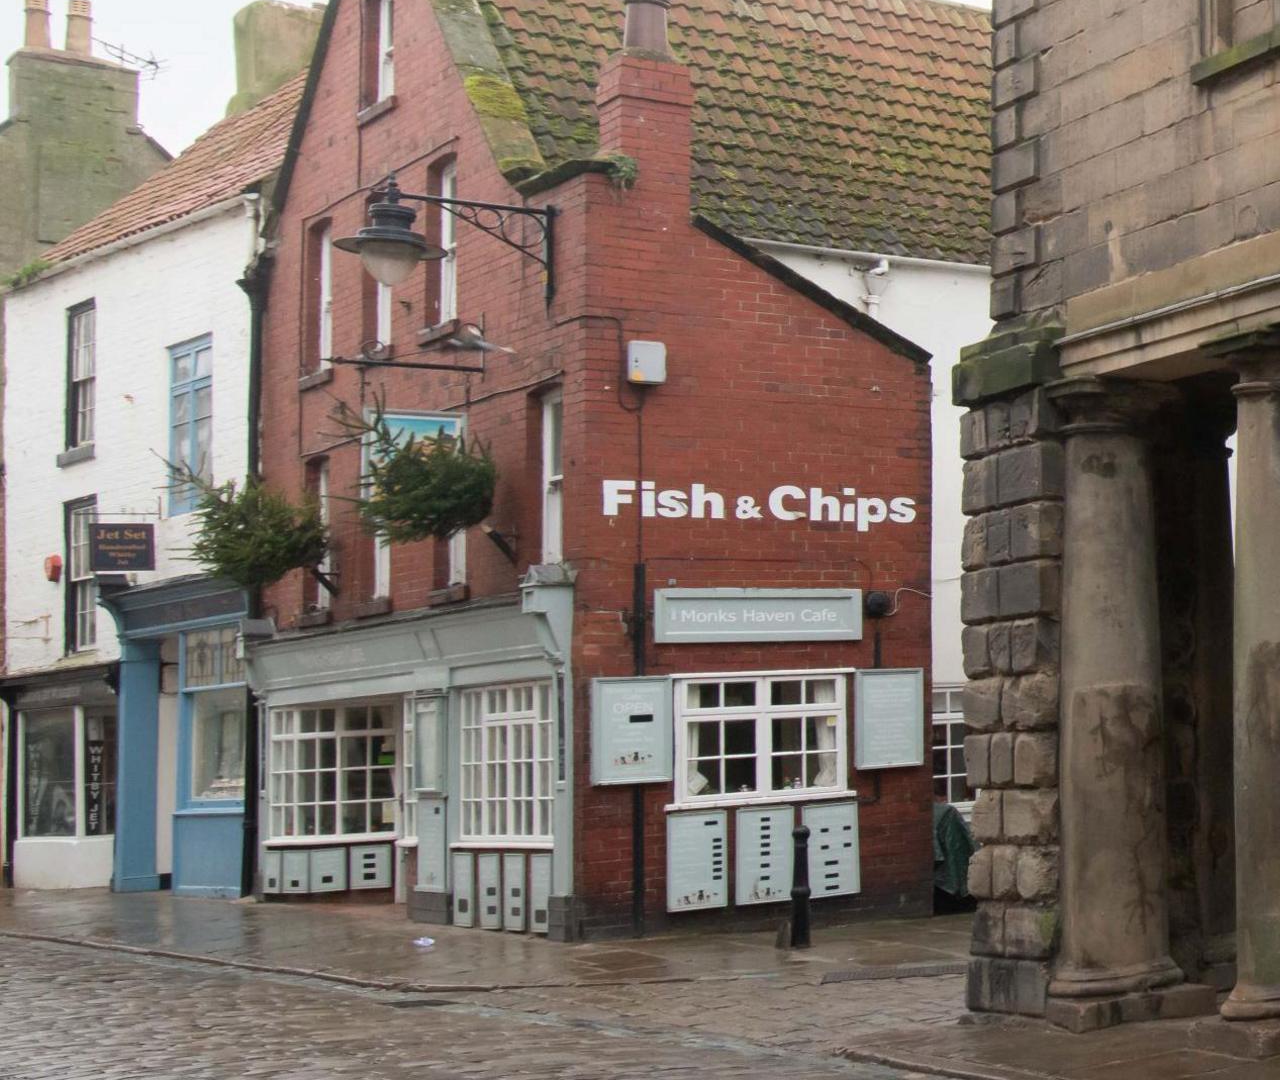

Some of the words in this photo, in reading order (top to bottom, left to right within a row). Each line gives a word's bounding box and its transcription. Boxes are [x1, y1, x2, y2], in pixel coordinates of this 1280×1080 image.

[602, 479, 725, 519] Fish
[735, 495, 763, 520] &
[768, 485, 917, 532] Chips
[96, 528, 119, 539] Jet
[124, 528, 146, 539] Set
[681, 609, 737, 623] Monks
[743, 608, 795, 622] Haven
[800, 607, 837, 622] Cafe
[613, 702, 654, 713] OPEN
[88, 745, 103, 800] WHITBY
[88, 802, 99, 831] JET
